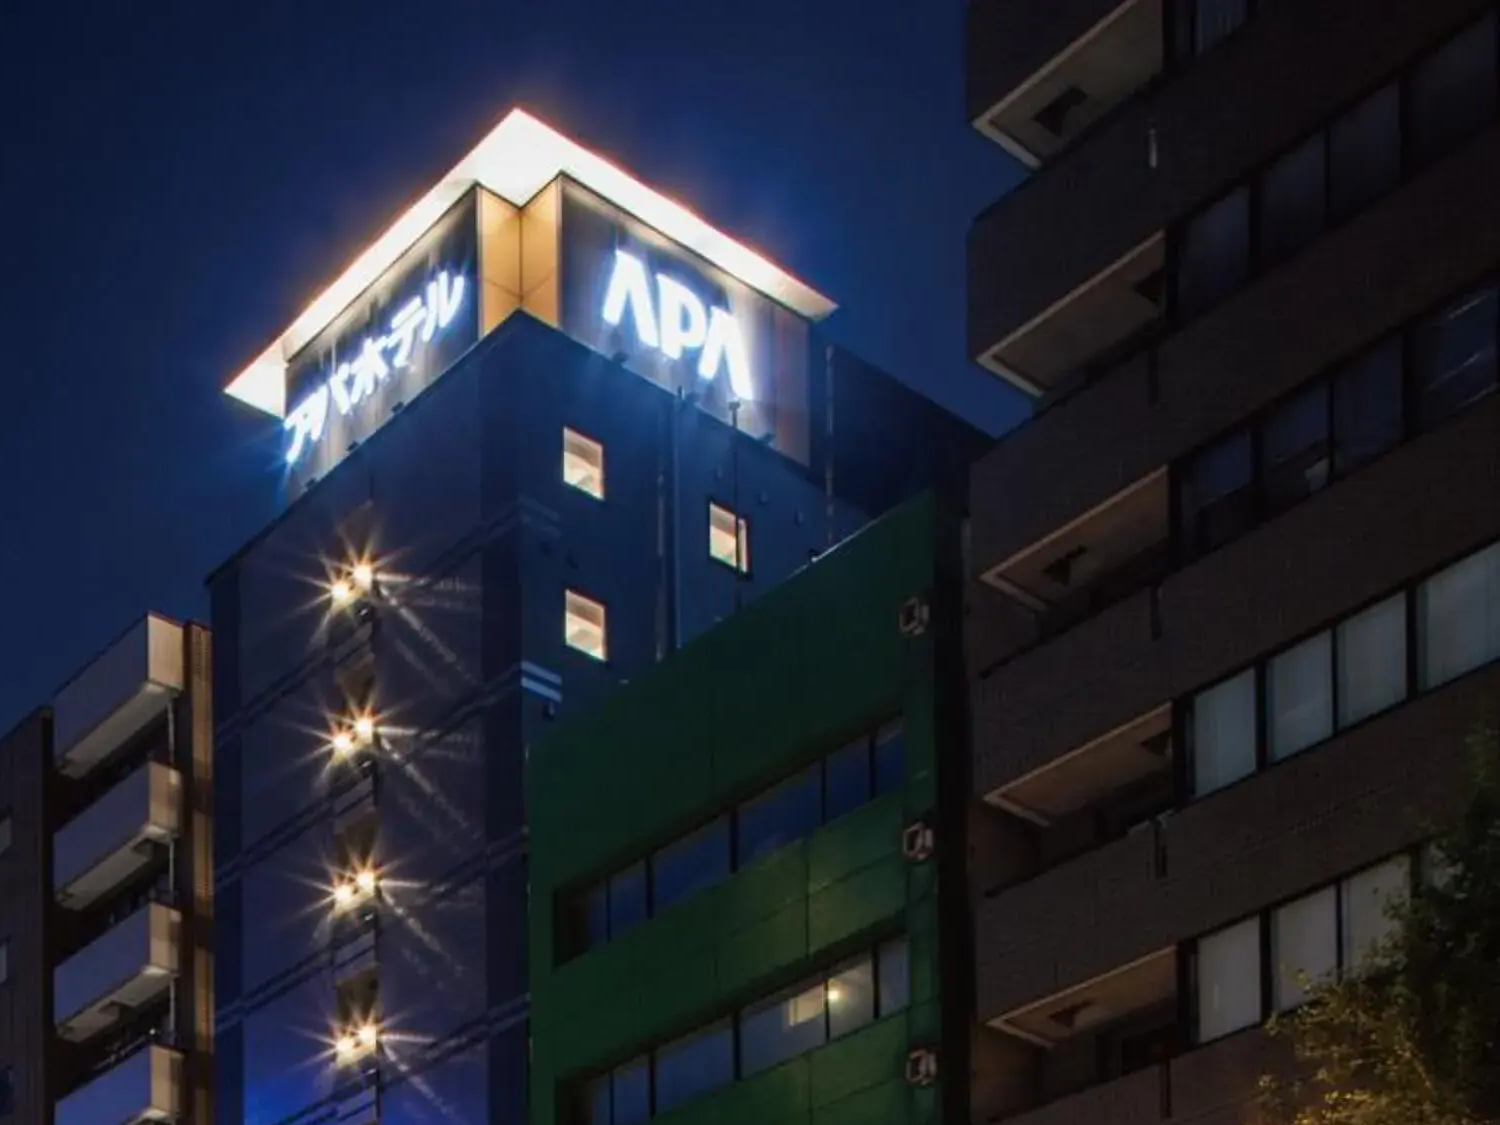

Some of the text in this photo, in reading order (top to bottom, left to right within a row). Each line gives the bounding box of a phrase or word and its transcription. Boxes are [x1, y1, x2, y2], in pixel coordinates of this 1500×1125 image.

[284, 270, 465, 464] アパホテル
[603, 249, 753, 401] APA
